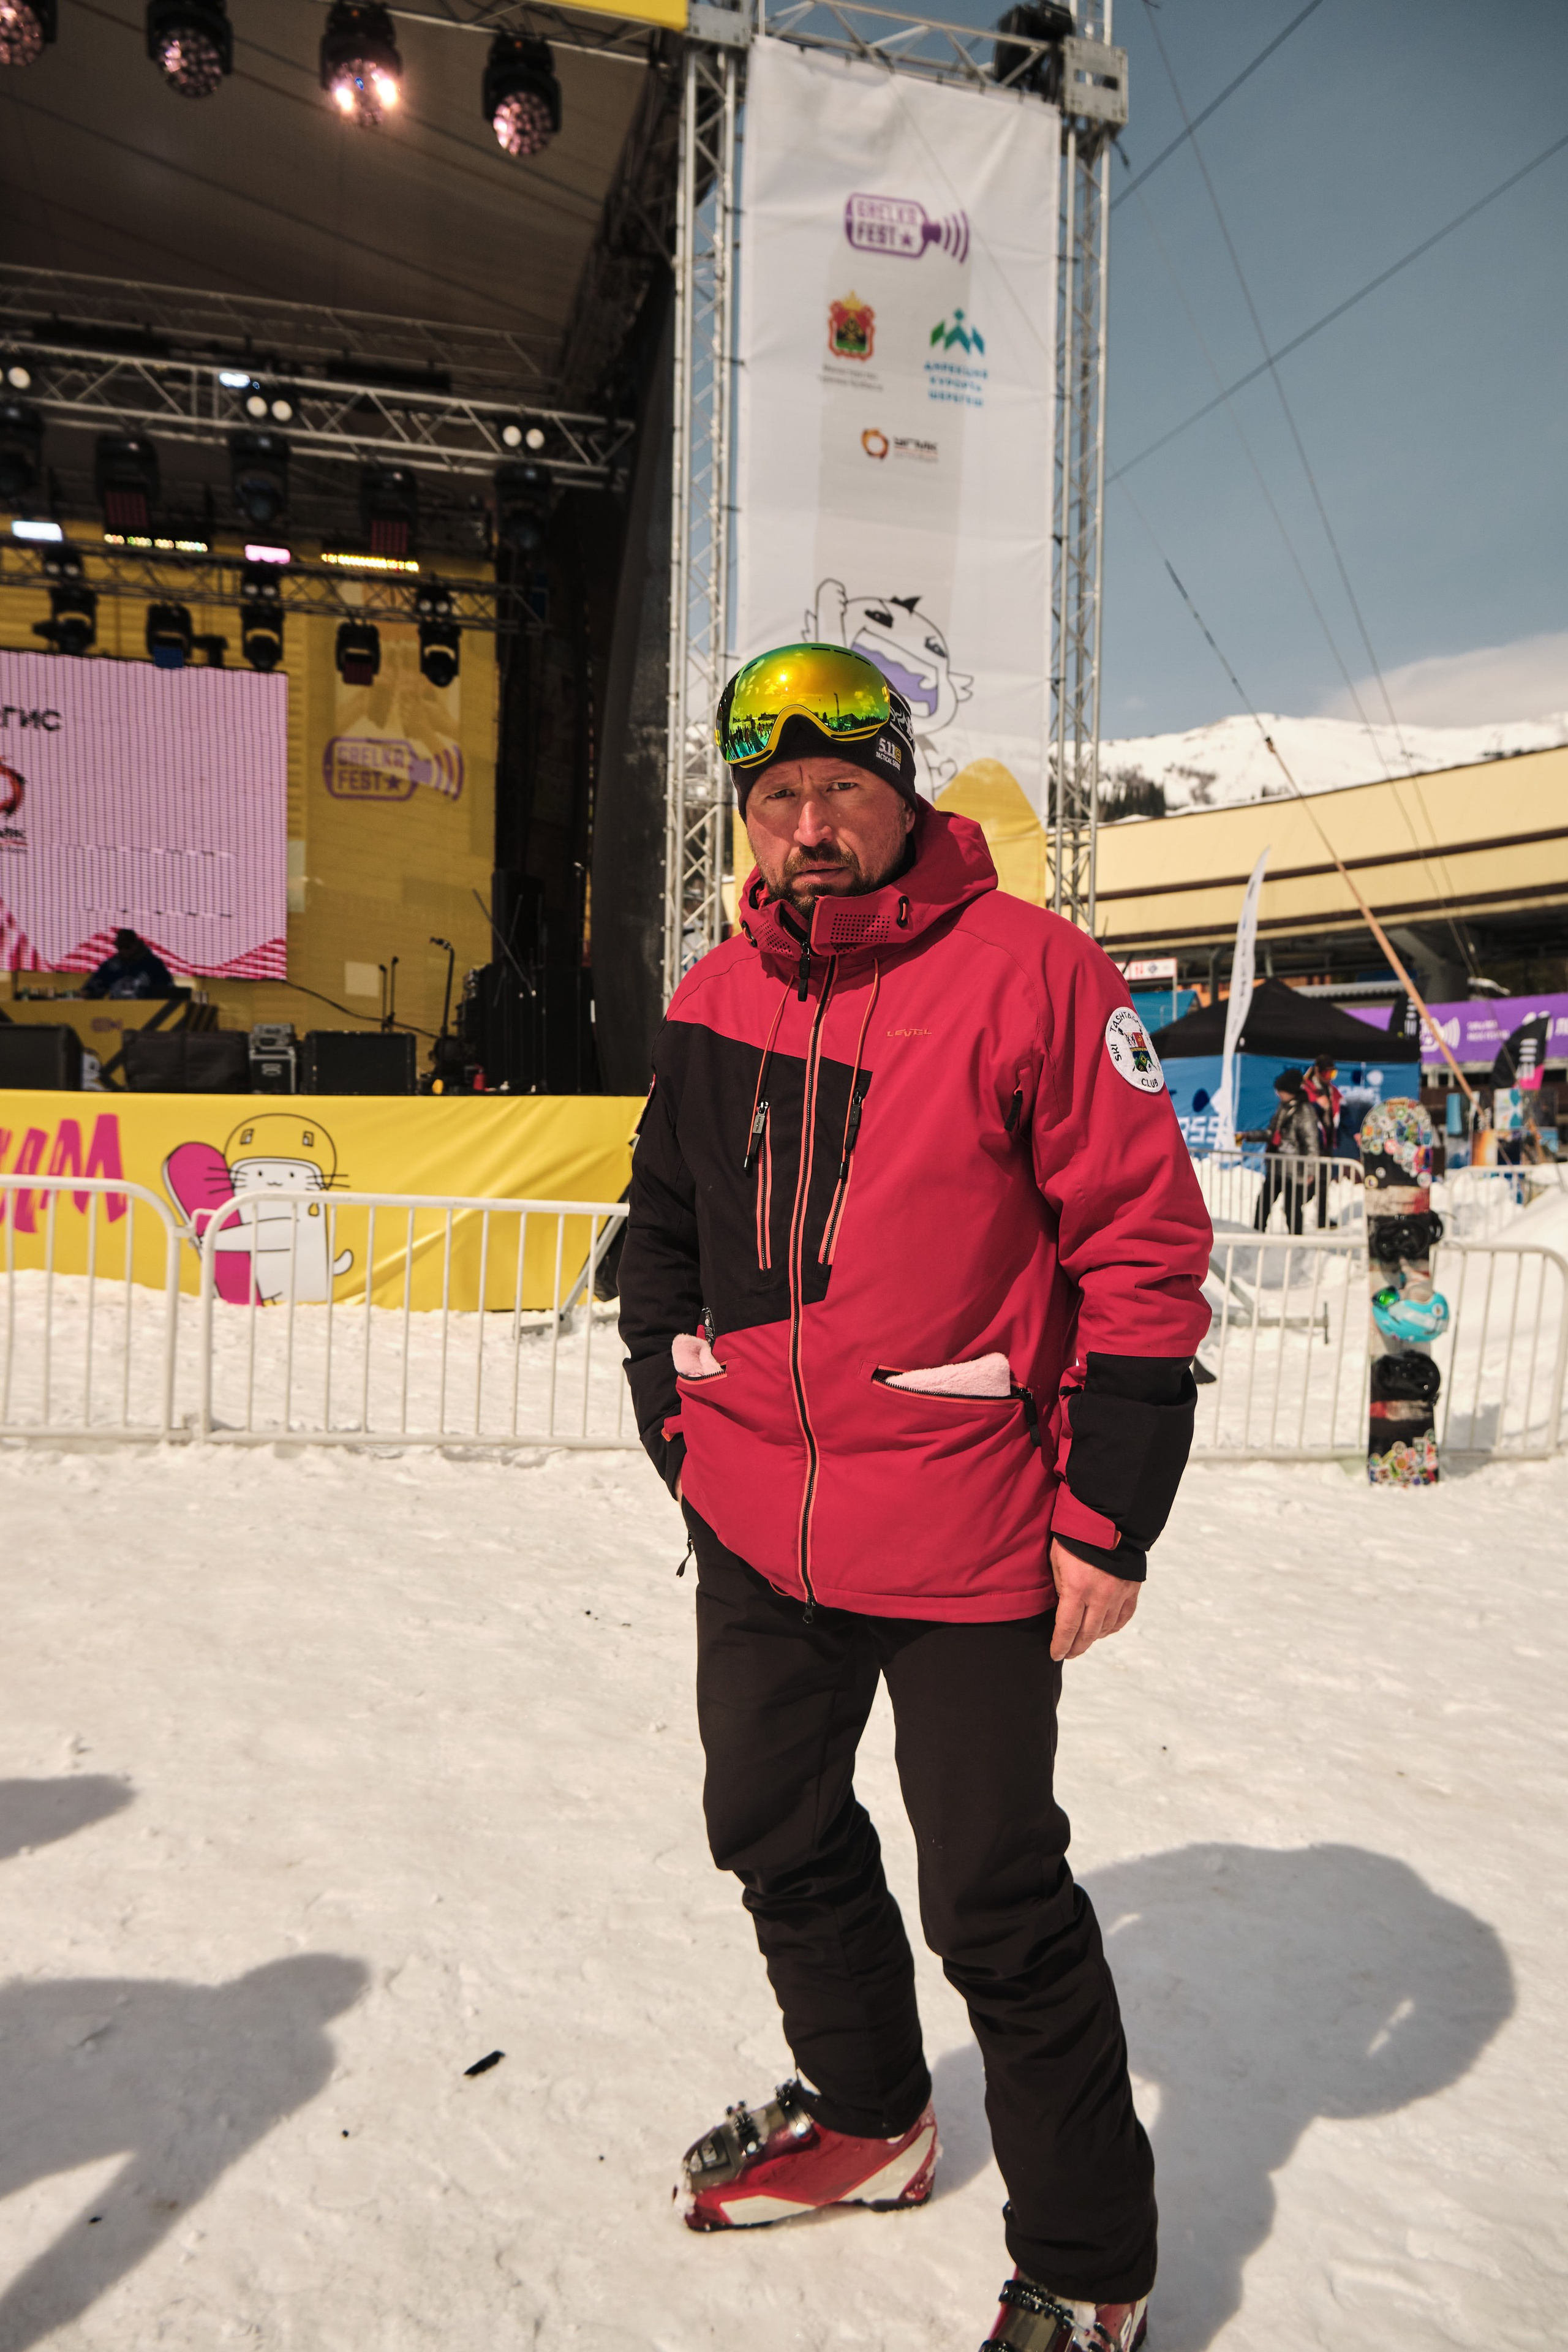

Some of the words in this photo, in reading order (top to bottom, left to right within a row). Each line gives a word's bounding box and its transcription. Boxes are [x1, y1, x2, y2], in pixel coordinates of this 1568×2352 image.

[858, 222, 895, 246] FEST
[0, 706, 61, 731] ГИС
[876, 751, 892, 765] TACTICAL
[337, 769, 381, 791] FEST
[887, 1028, 933, 1037] LEVEL
[1110, 1044, 1123, 1061] SKI
[1141, 1078, 1159, 1088] CLUB
